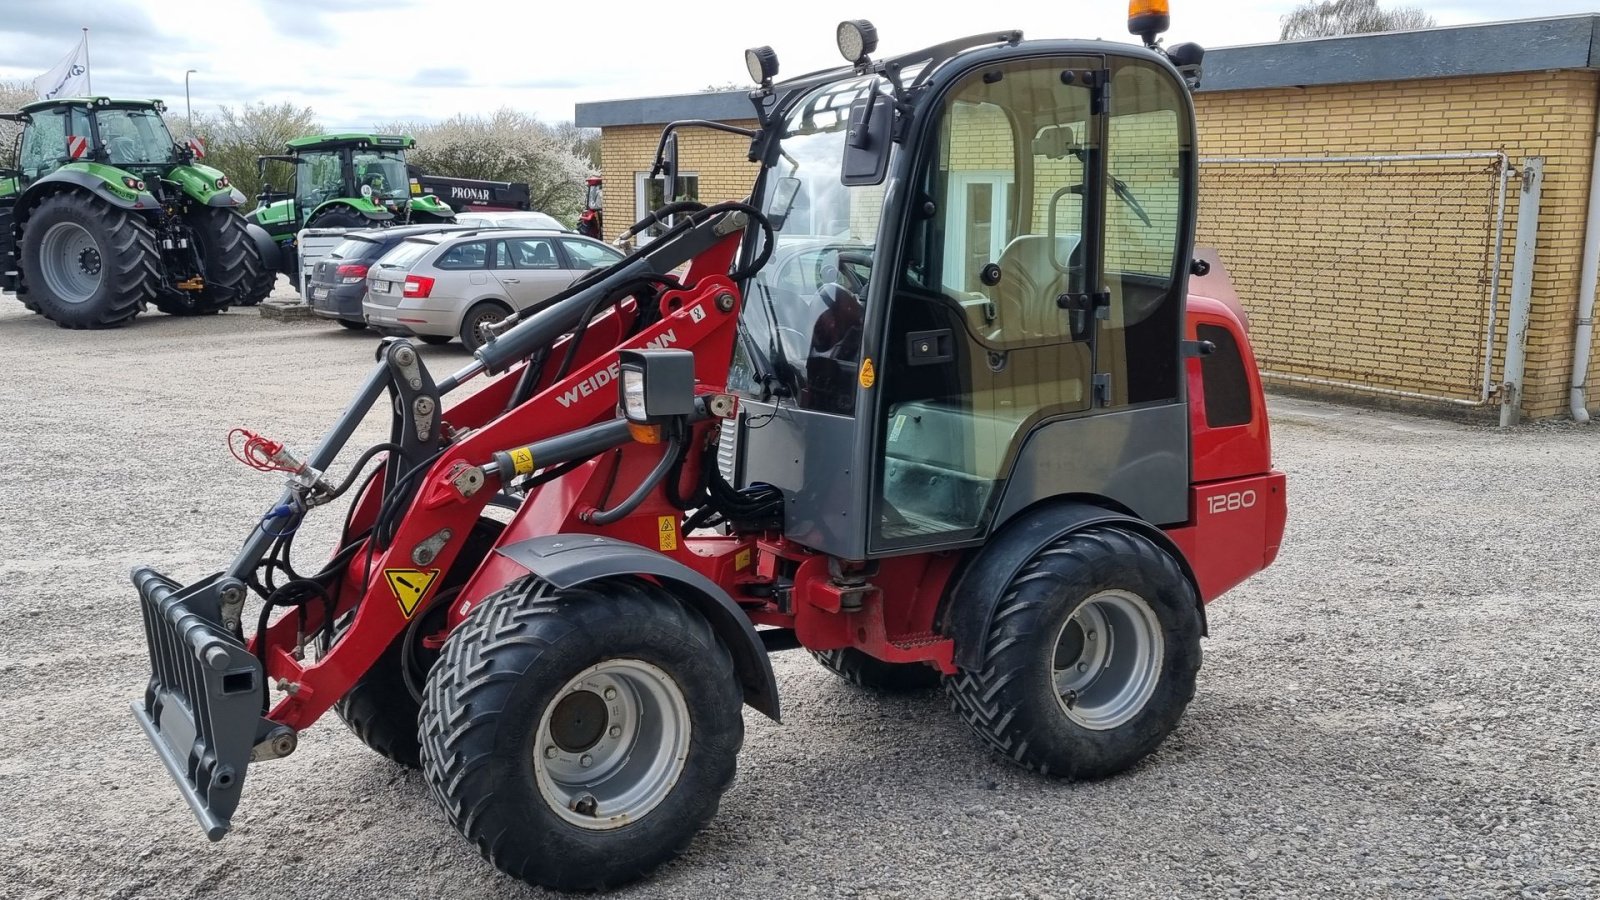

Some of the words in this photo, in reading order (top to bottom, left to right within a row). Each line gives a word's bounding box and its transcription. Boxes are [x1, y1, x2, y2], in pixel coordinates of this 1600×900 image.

[451, 186, 490, 200] PRONAR
[555, 328, 677, 408] WEIDENN
[1207, 489, 1256, 514] 1280
